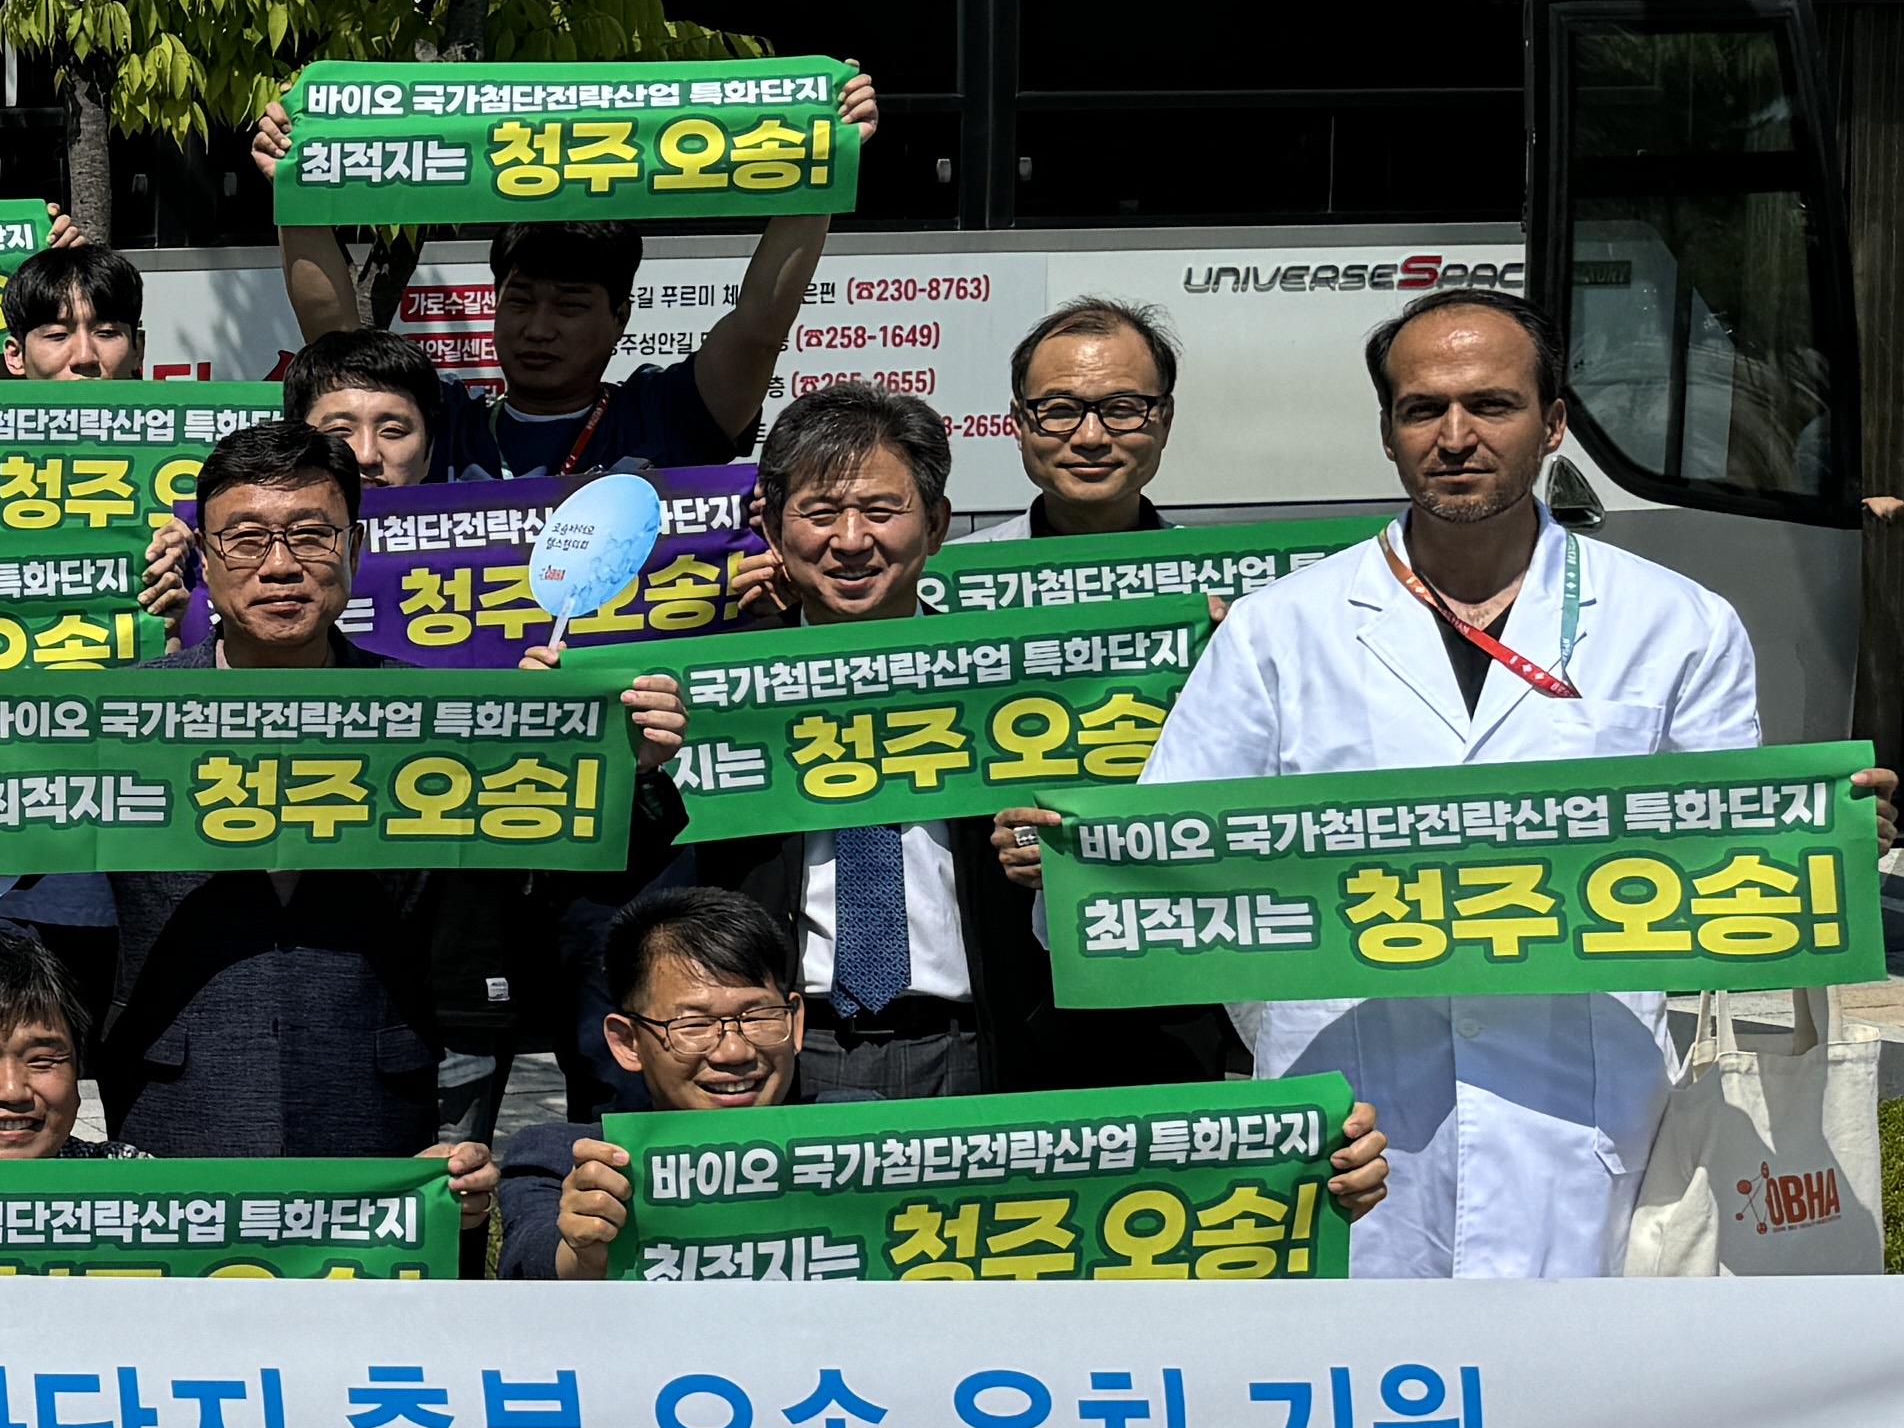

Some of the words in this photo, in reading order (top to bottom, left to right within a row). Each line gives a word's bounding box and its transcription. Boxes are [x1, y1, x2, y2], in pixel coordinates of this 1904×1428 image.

[309, 85, 403, 115] 바이오
[413, 83, 679, 114] 국가첨단전략산업
[690, 76, 827, 104] 특화단지
[302, 141, 467, 182] 최적지는
[491, 122, 638, 195] 청주
[654, 119, 830, 189] 오송!
[406, 292, 496, 316] 가로수길센
[661, 285, 714, 308] 푸르미
[611, 331, 694, 357] 주성안길
[690, 644, 1010, 706] 국가첨단전략산업
[1024, 628, 1188, 675] 특화단지
[101, 701, 422, 738] 국가첨단전략산업
[434, 701, 599, 737] 특화단지
[792, 708, 969, 797] 청주
[195, 757, 368, 841] 청주
[387, 758, 598, 838] 오송!
[1079, 819, 1214, 860] 바이오
[1226, 795, 1609, 854] 국가첨단전략산업
[1624, 783, 1826, 832] 특화단지
[1085, 895, 1313, 950] 최적지는
[1346, 865, 1558, 962] 청주
[1583, 855, 1840, 954] 오송!
[652, 1148, 778, 1199] 바이오
[793, 1124, 1136, 1188] 국가첨단전략산업
[1149, 1111, 1319, 1163] 특화단지
[239, 1197, 416, 1242] 특화단지
[1094, 1183, 1317, 1278] 오송!
